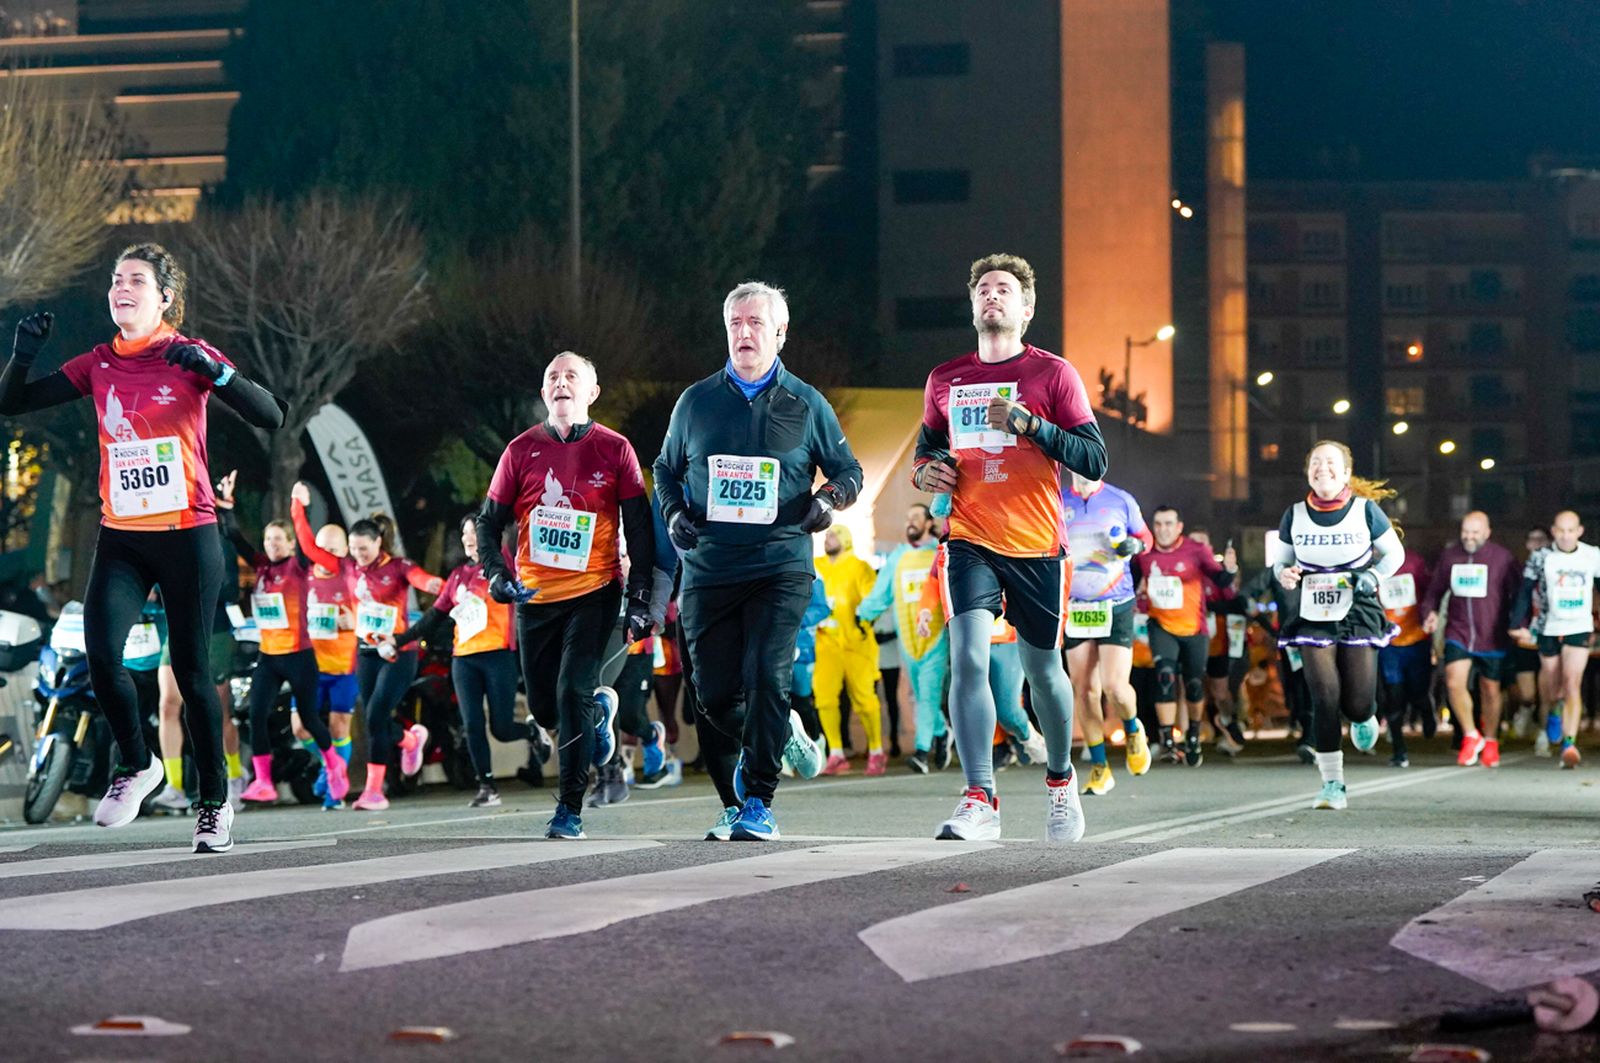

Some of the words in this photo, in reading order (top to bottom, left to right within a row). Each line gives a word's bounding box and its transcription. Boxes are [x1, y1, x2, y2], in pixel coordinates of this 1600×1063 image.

[964, 390, 982, 398] NOCHE
[956, 399, 968, 407] SAN
[962, 405, 990, 426] 812
[119, 449, 138, 458] NOCHE
[115, 459, 126, 468] SAN
[723, 462, 744, 470] NOCHE
[120, 465, 169, 491] 5360
[345, 436, 383, 508] MASA
[719, 479, 766, 501] 2625
[539, 527, 582, 550] 3063
[1294, 532, 1364, 546] CHEERS
[1312, 591, 1342, 605] 1857
[1072, 611, 1106, 623] 12635
